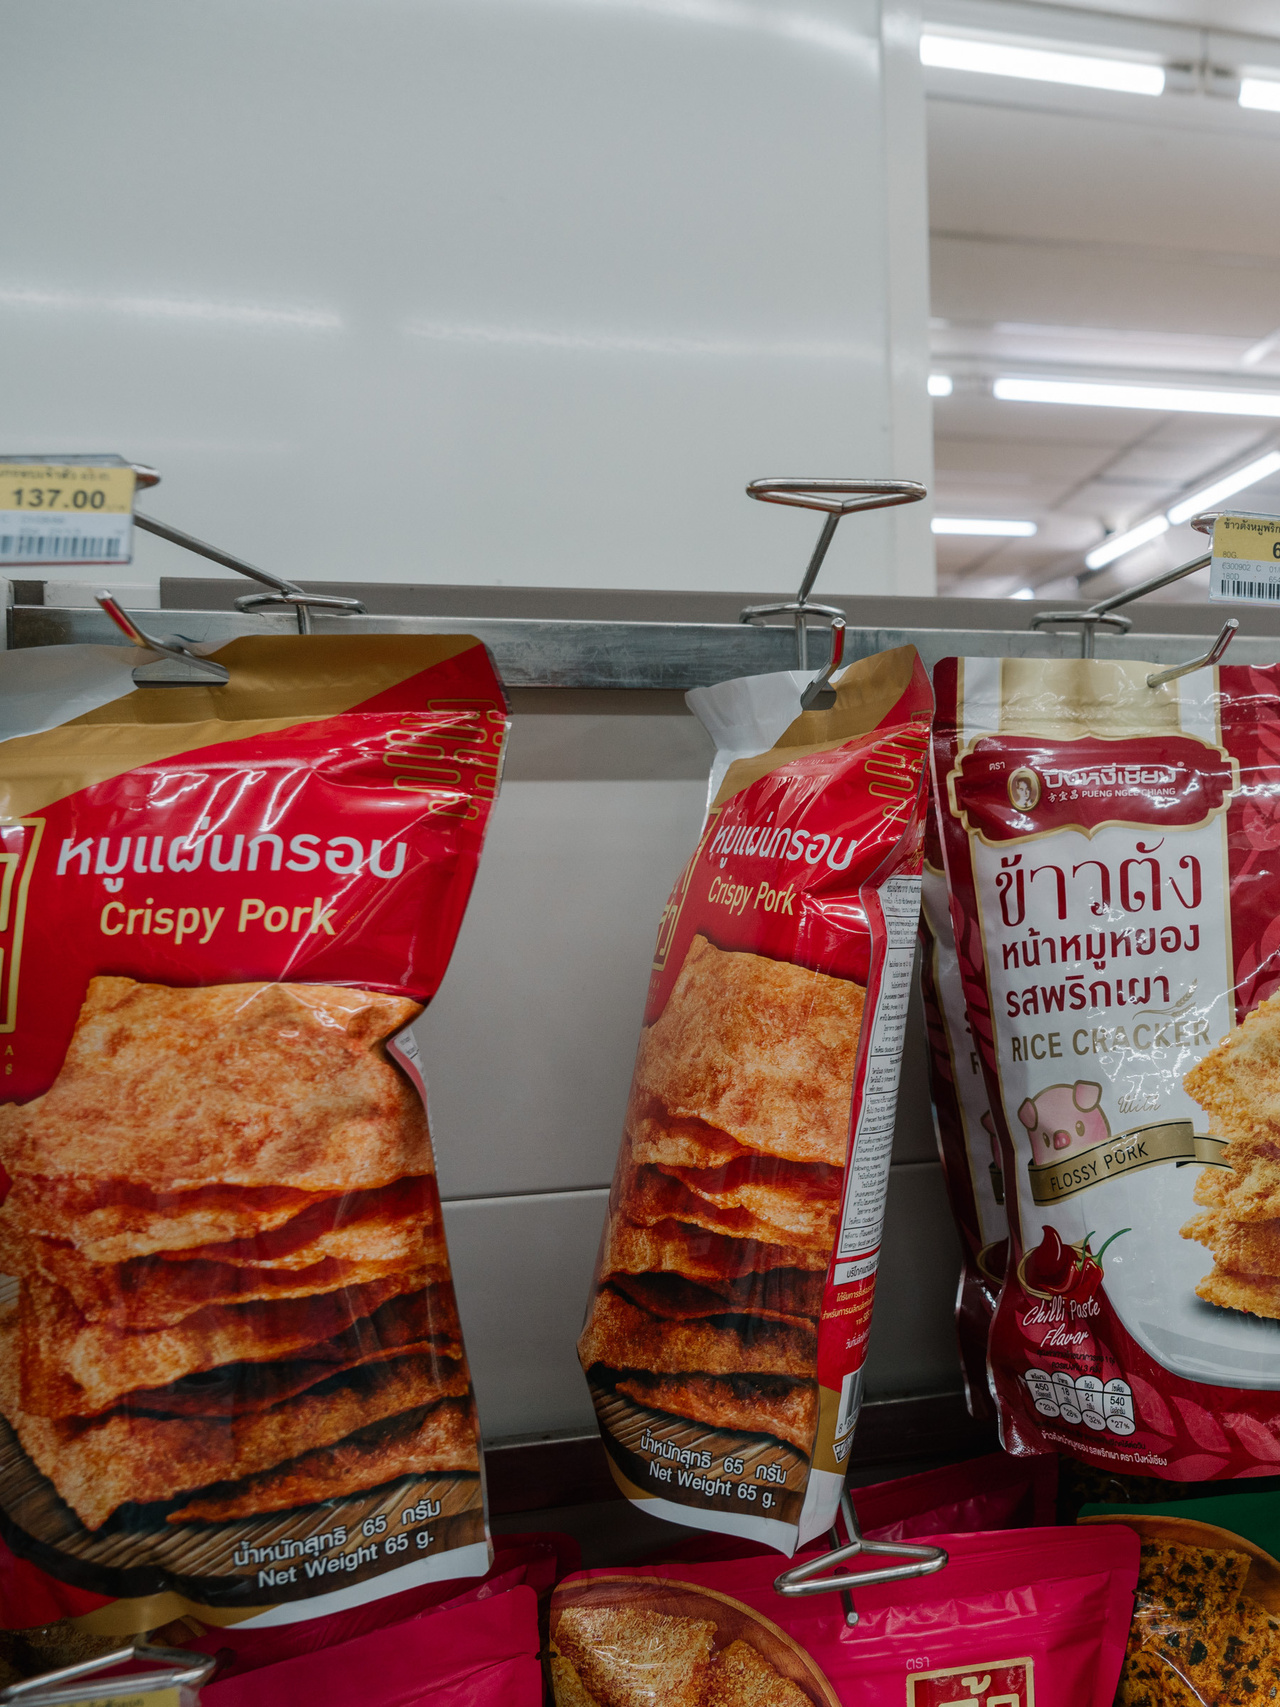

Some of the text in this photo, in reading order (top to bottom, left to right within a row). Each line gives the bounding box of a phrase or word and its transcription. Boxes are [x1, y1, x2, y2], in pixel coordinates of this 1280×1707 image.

[13, 489, 105, 509] 137.00
[989, 761, 1006, 771] ตรา
[1081, 790, 1113, 799] PUENG
[1141, 787, 1176, 797] CHIANG
[56, 816, 406, 891] หมูแผ่นกรอบ
[709, 811, 857, 871] หมูแผ่นกรอบ
[708, 876, 797, 916] Crispy Pork
[995, 837, 1202, 927] ข้าวตัง
[99, 897, 337, 945] Crispy Pork
[1002, 924, 1200, 971] หน้าหมูหยอง
[1006, 974, 1170, 1018] รสพริกเผา
[1011, 1018, 1212, 1062] RICE CRACKER
[1050, 1141, 1149, 1192] FLOSSY PORK
[1022, 1295, 1101, 1326] Chilli Paste
[1040, 1322, 1090, 1347] Flavor
[1035, 1382, 1049, 1392] 450
[1061, 1387, 1070, 1396] 18
[1084, 1393, 1094, 1403] 21
[1110, 1396, 1126, 1407] 540
[640, 1428, 787, 1485] น้ำหนักสุทธิ 65 กรัม
[649, 1461, 776, 1509] Net Weight 65 g.
[233, 1499, 442, 1567] น้ำหนักสุทธิ 65 กรัม
[258, 1530, 436, 1589] Net Weight 65 g.
[906, 1656, 930, 1670] ตรา
